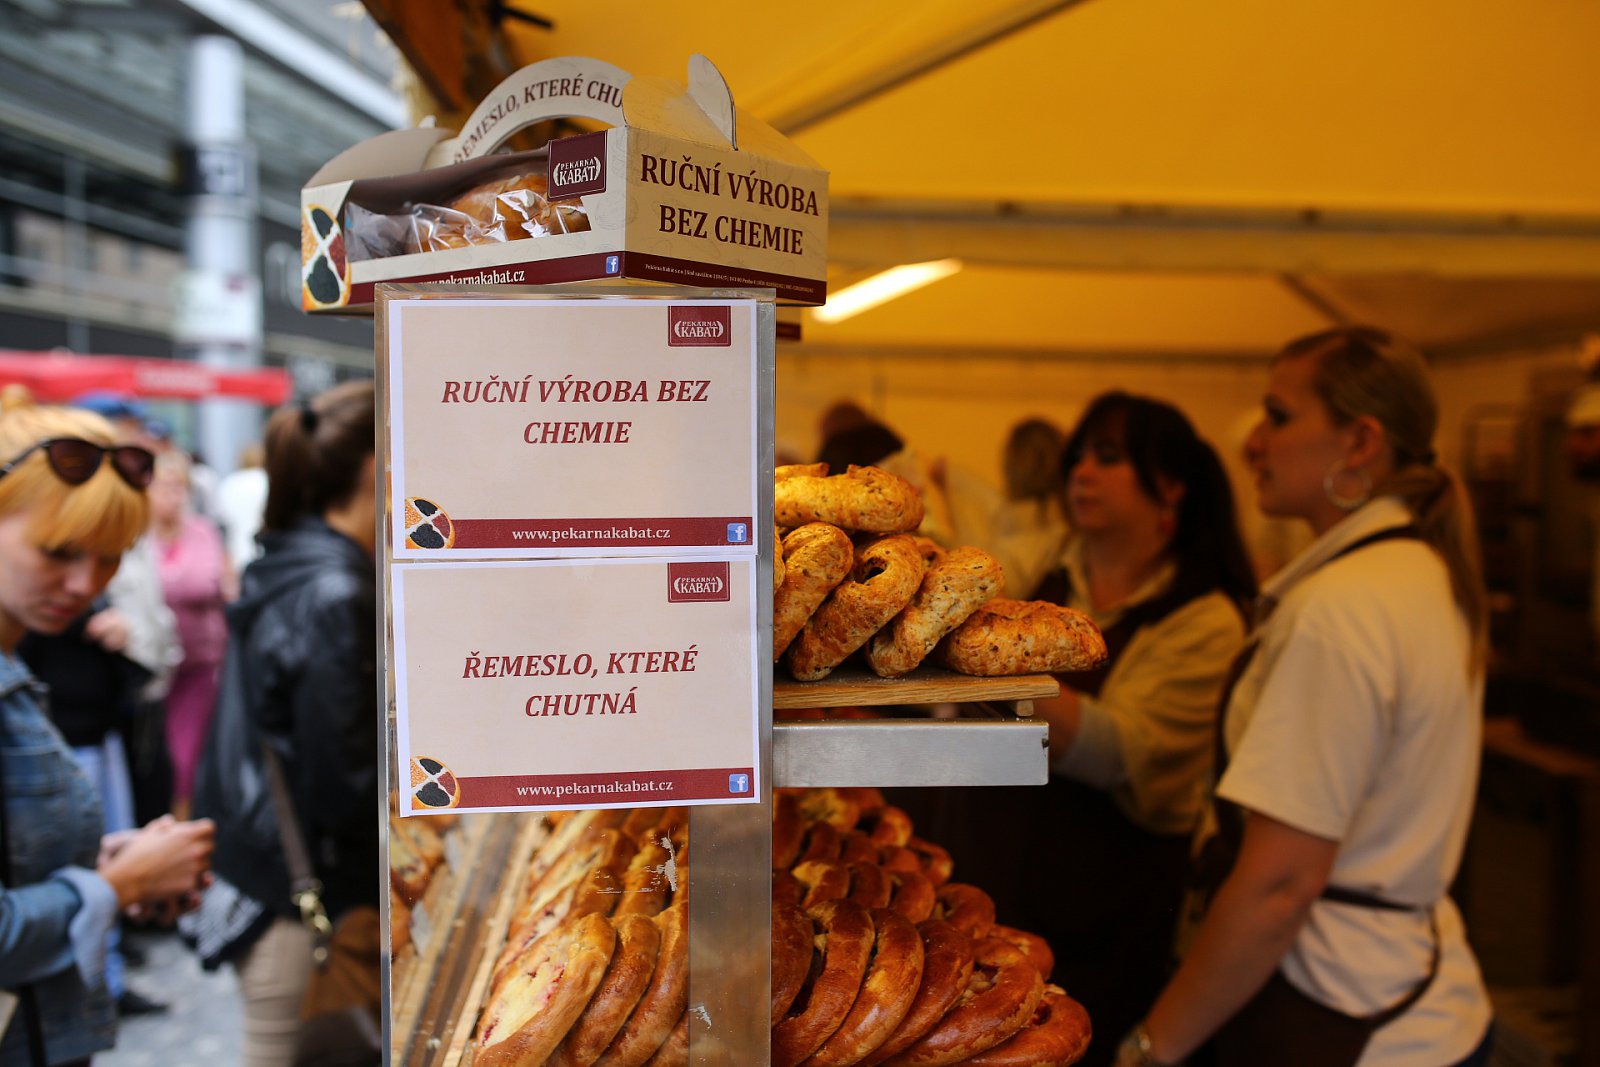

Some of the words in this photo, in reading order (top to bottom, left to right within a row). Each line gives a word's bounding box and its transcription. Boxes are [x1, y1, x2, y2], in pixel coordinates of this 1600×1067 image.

[524, 73, 584, 104] KTERÉ
[640, 154, 721, 196] RUČNÍ
[727, 170, 819, 216] VÝROBA
[659, 204, 708, 239] BEZ
[714, 215, 803, 255] CHEMIE
[441, 375, 534, 404] RUČNÍ
[539, 374, 649, 403] VÝROBA
[657, 380, 711, 402] BEZ
[523, 421, 632, 445] CHEMIE
[512, 526, 671, 543] www.pekarnakabat.cz
[462, 650, 599, 679] ŘEMESLO,
[606, 644, 699, 674] KTERÉ
[525, 687, 638, 717] CHUTNÁ
[516, 780, 674, 798] www.pekarnakabat.cz
